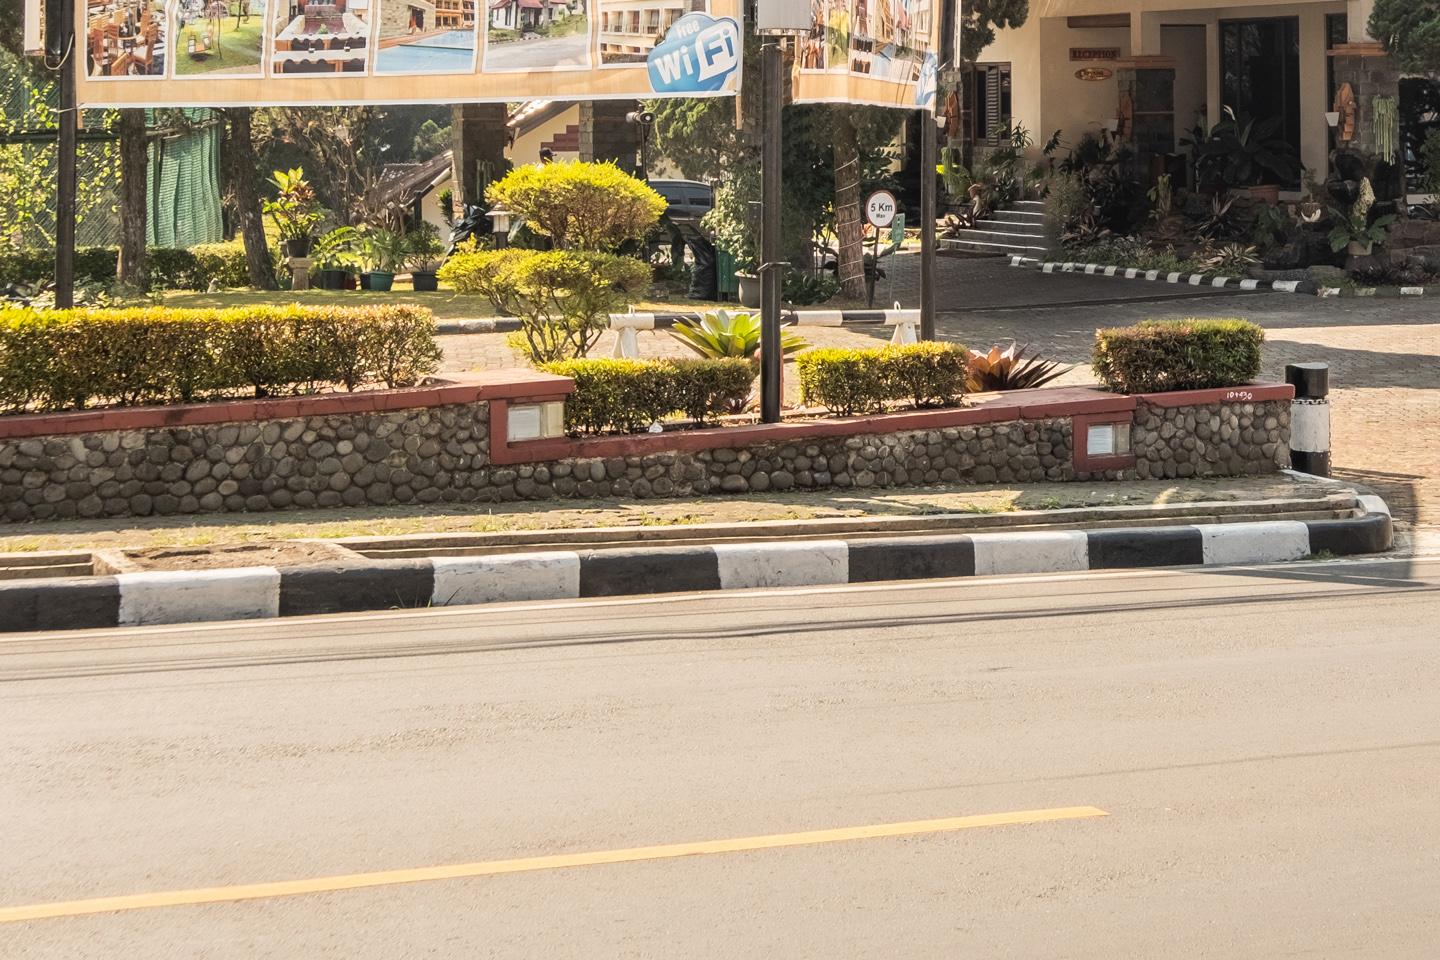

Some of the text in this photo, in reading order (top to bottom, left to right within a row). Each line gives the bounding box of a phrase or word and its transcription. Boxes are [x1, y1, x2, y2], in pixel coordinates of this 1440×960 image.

[675, 19, 700, 39] Free
[1072, 50, 1117, 59] RECEPTION
[870, 203, 893, 212] 5 Km
